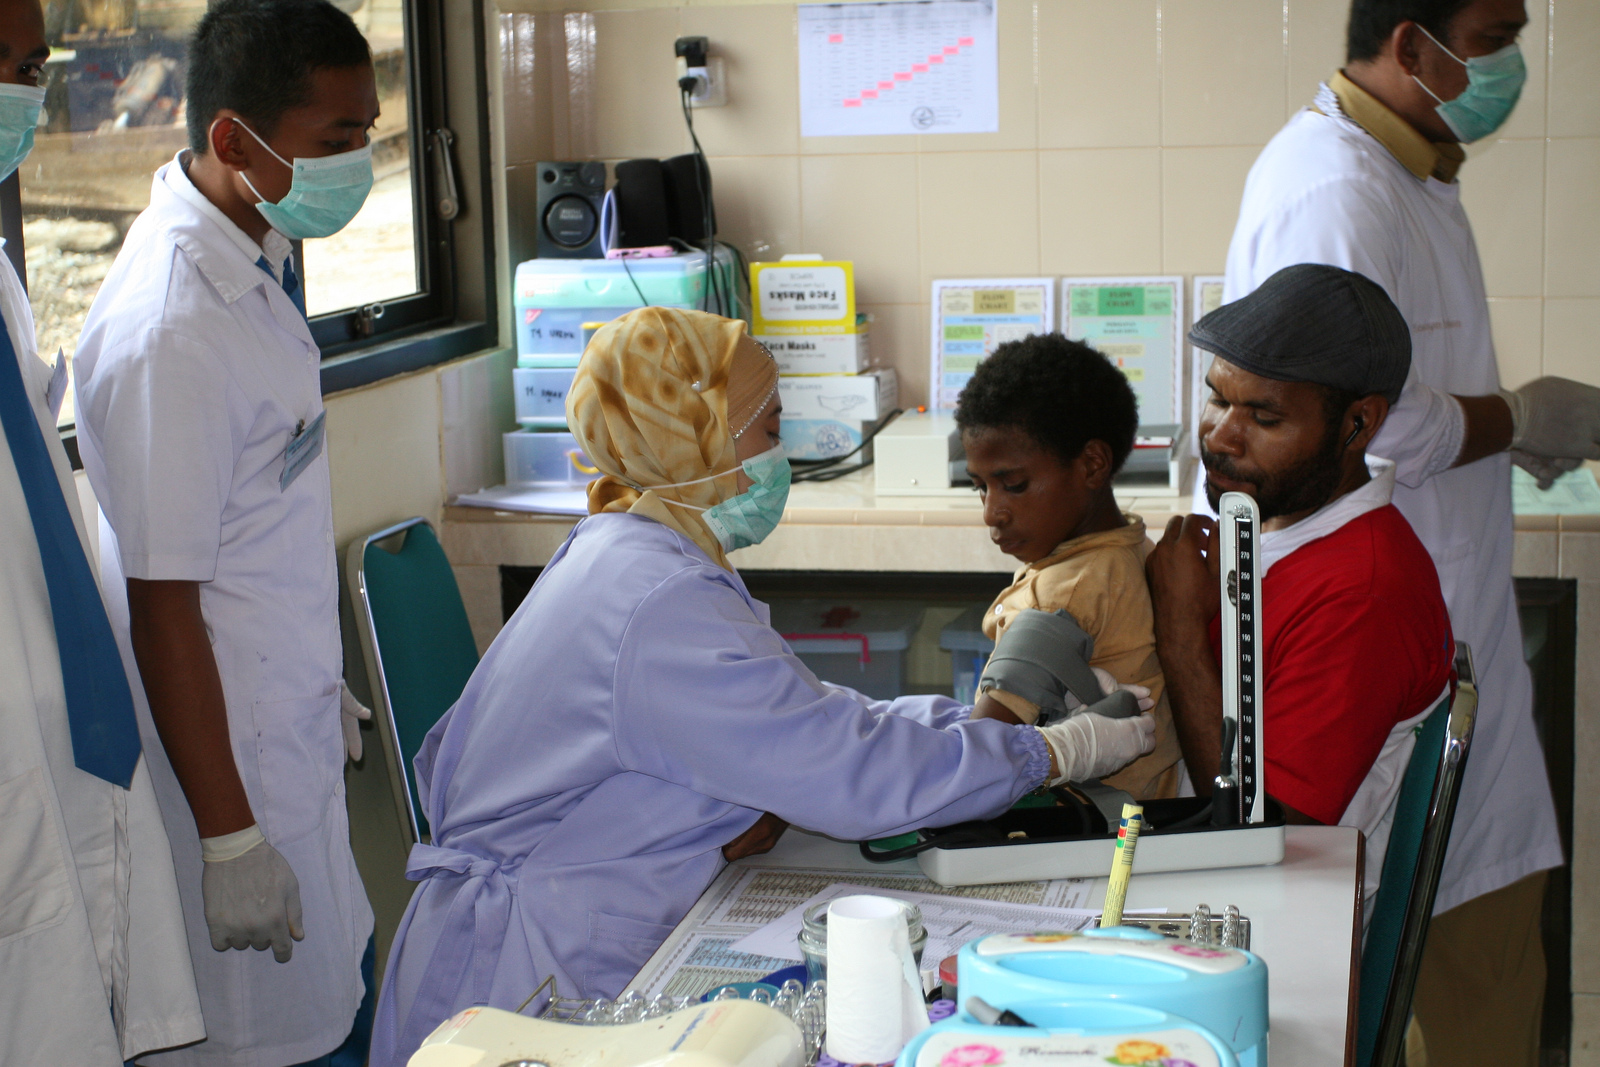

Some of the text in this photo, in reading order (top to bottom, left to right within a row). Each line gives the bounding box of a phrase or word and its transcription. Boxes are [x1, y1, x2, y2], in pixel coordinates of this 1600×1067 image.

[769, 290, 836, 301] Face Masks
[787, 340, 817, 351] Masks
[1240, 530, 1250, 539] 290
[1240, 550, 1250, 560] 270
[1240, 571, 1250, 581] 250
[1241, 592, 1251, 601] 230
[1241, 612, 1251, 622] 210
[1241, 633, 1251, 642] 190
[1242, 653, 1252, 663] 170
[1242, 674, 1252, 683] 150
[1242, 694, 1252, 704] 130
[1243, 715, 1253, 724] 110
[1244, 735, 1252, 744] 90
[1244, 755, 1252, 764] 70
[1244, 775, 1252, 785] 50
